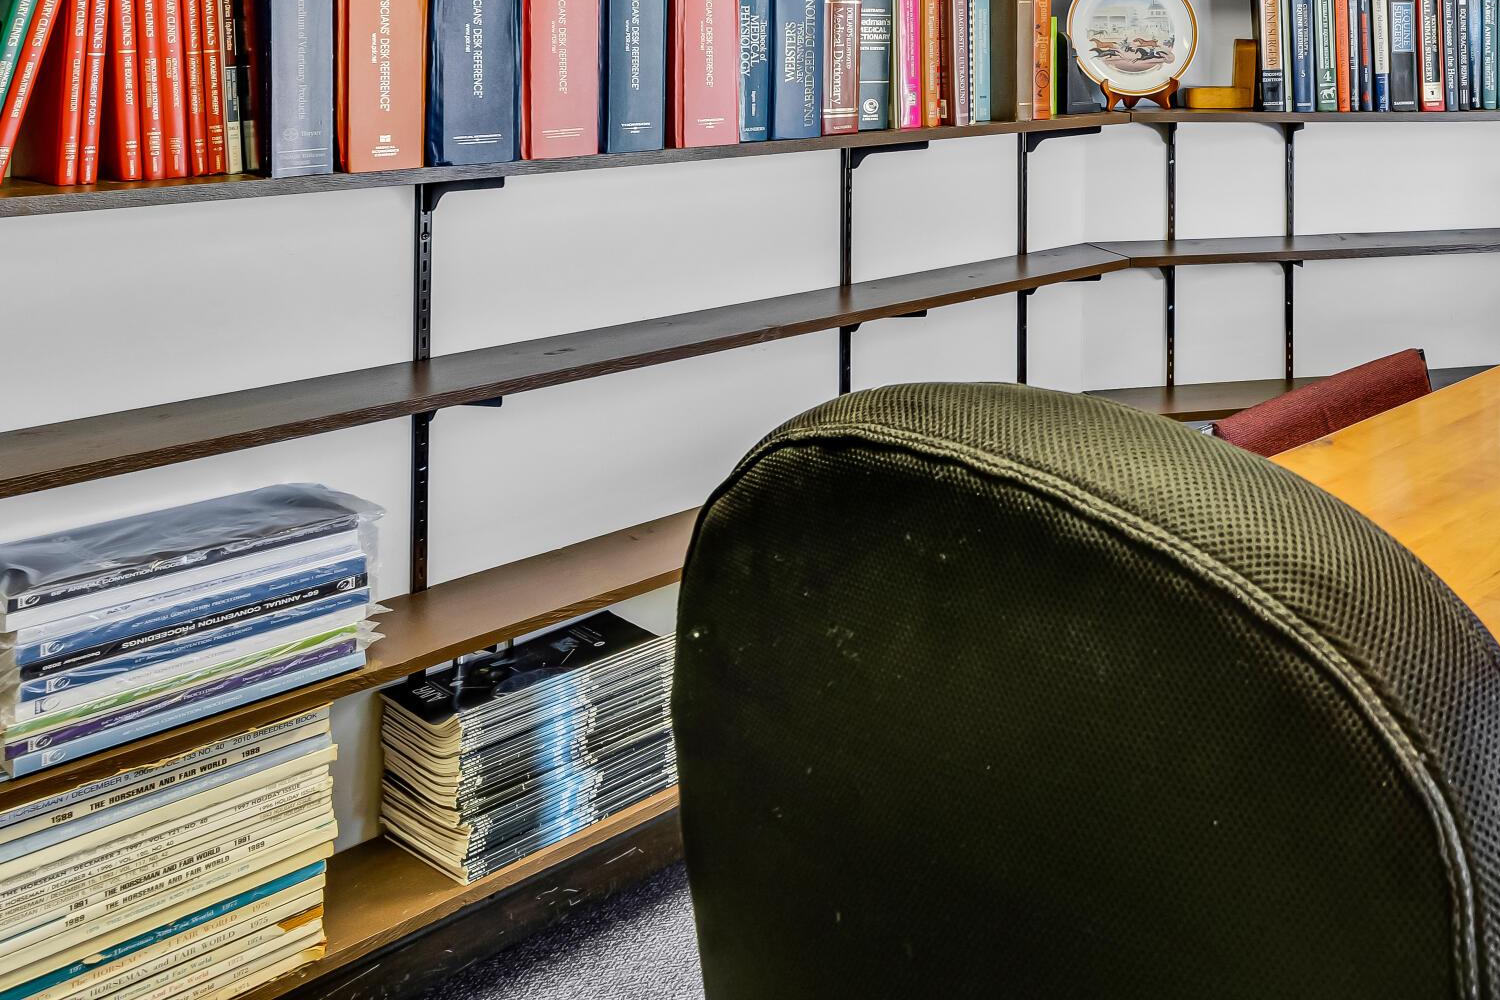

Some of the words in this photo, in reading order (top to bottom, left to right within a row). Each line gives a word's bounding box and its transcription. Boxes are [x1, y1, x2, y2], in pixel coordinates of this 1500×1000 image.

[75, 11, 85, 36] CLINICS
[94, 17, 104, 48] CLINICS
[123, 16, 132, 46] CLINICS
[473, 28, 482, 48] DESK
[759, 20, 768, 53] Textbook
[834, 7, 844, 47] Medical
[1394, 6, 1402, 48] SURGERY
[380, 38, 390, 61] DESK
[740, 5, 750, 77] PHYSIOLOGY
[751, 15, 759, 67] MEDICAL
[784, 22, 796, 82] WEBSTER'S
[804, 50, 815, 127] UNABRIDGED
[832, 48, 843, 104] Dictionary
[1323, 71, 1331, 81] 4
[198, 606, 261, 628] CONVENTION
[122, 624, 196, 648] PROCEEDINGS
[233, 735, 251, 745] 2010
[253, 722, 294, 739] BREEDERS
[295, 712, 317, 725] BOOK
[90, 801, 106, 811] THE
[109, 783, 155, 805] HORSEMAN
[158, 777, 175, 787] AND
[179, 769, 197, 780] FAIR
[199, 758, 227, 773] WORLD
[242, 747, 260, 758] 1988
[104, 886, 117, 897] THE
[119, 872, 160, 892] HORSEMAN
[163, 863, 177, 873] AND
[179, 856, 194, 868] FAIR
[196, 847, 220, 860] WORLD
[65, 915, 85, 927] 1989
[123, 883, 164, 903] HORSEMAN
[205, 856, 229, 870] WORLD
[174, 948, 196, 961] FAIR
[201, 931, 235, 949] WORLD
